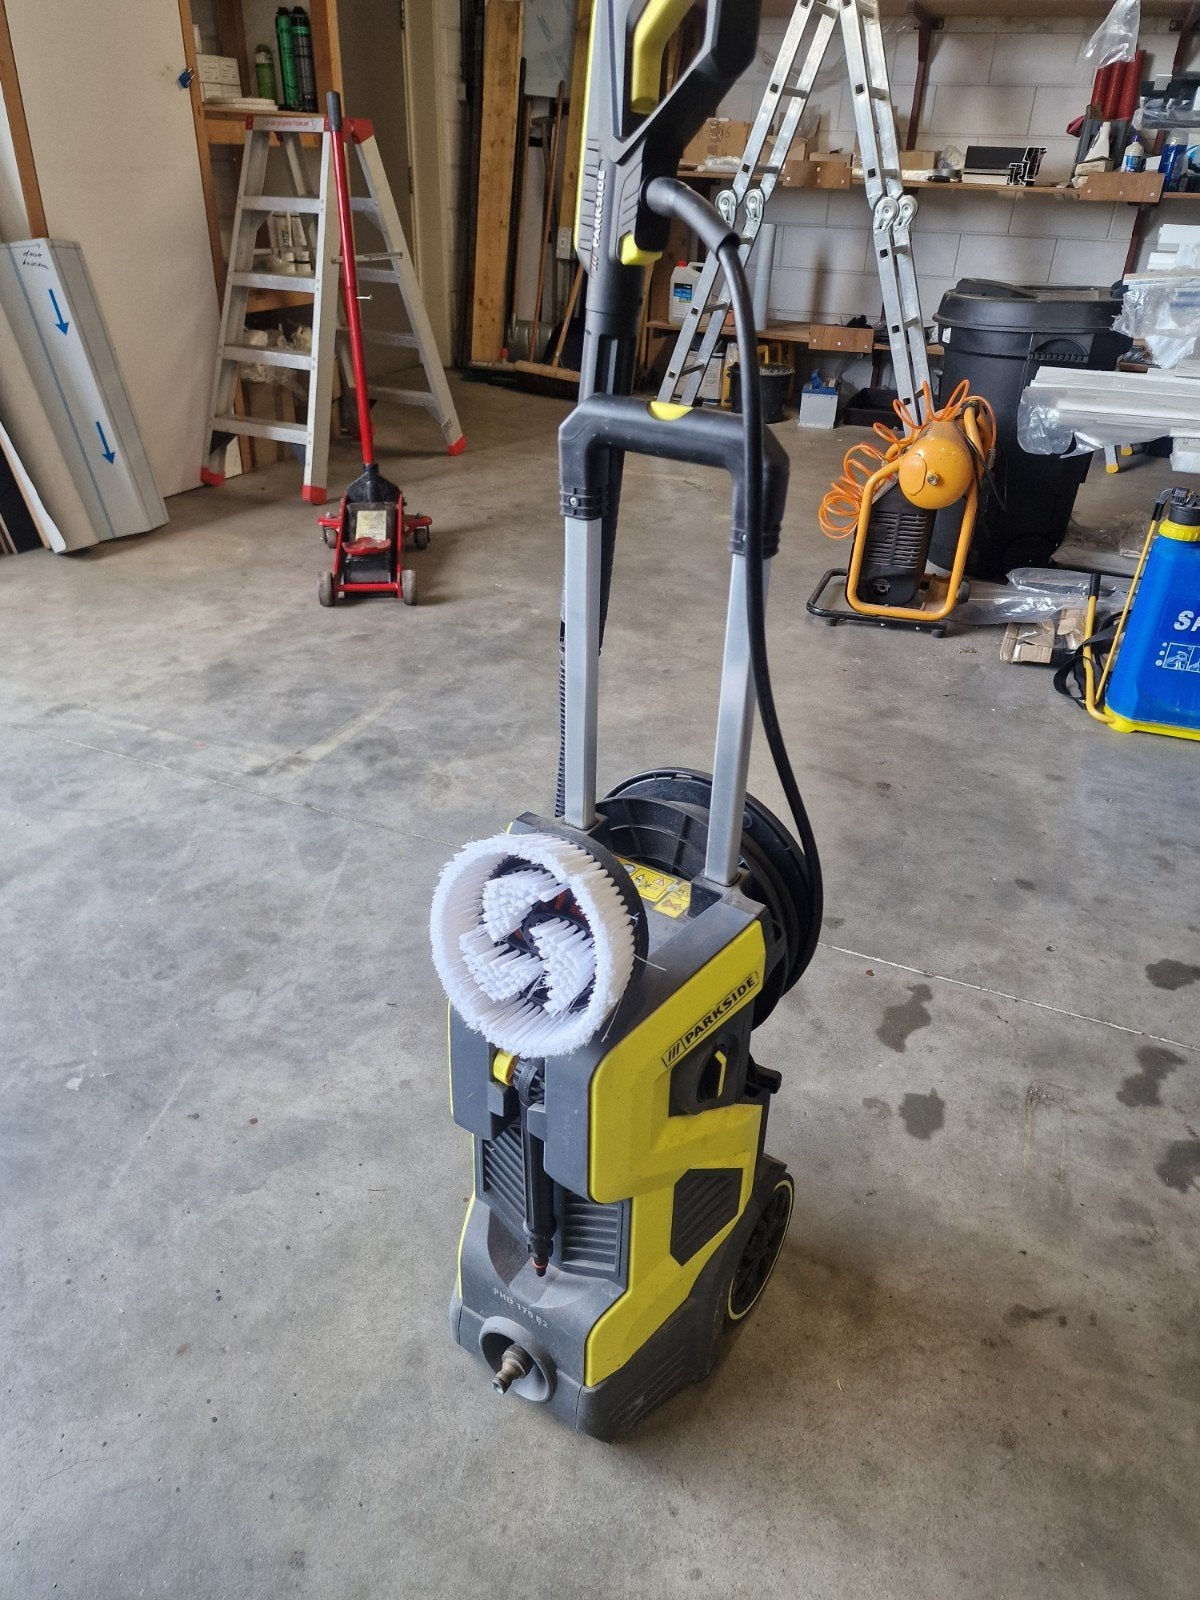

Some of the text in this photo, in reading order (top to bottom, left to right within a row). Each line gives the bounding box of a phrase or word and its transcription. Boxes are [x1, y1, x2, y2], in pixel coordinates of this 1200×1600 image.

[592, 170, 606, 248] PARKSIDE
[684, 976, 755, 1044] PARKSIDE
[493, 1287, 514, 1305] PHD
[516, 1302, 534, 1319] 170
